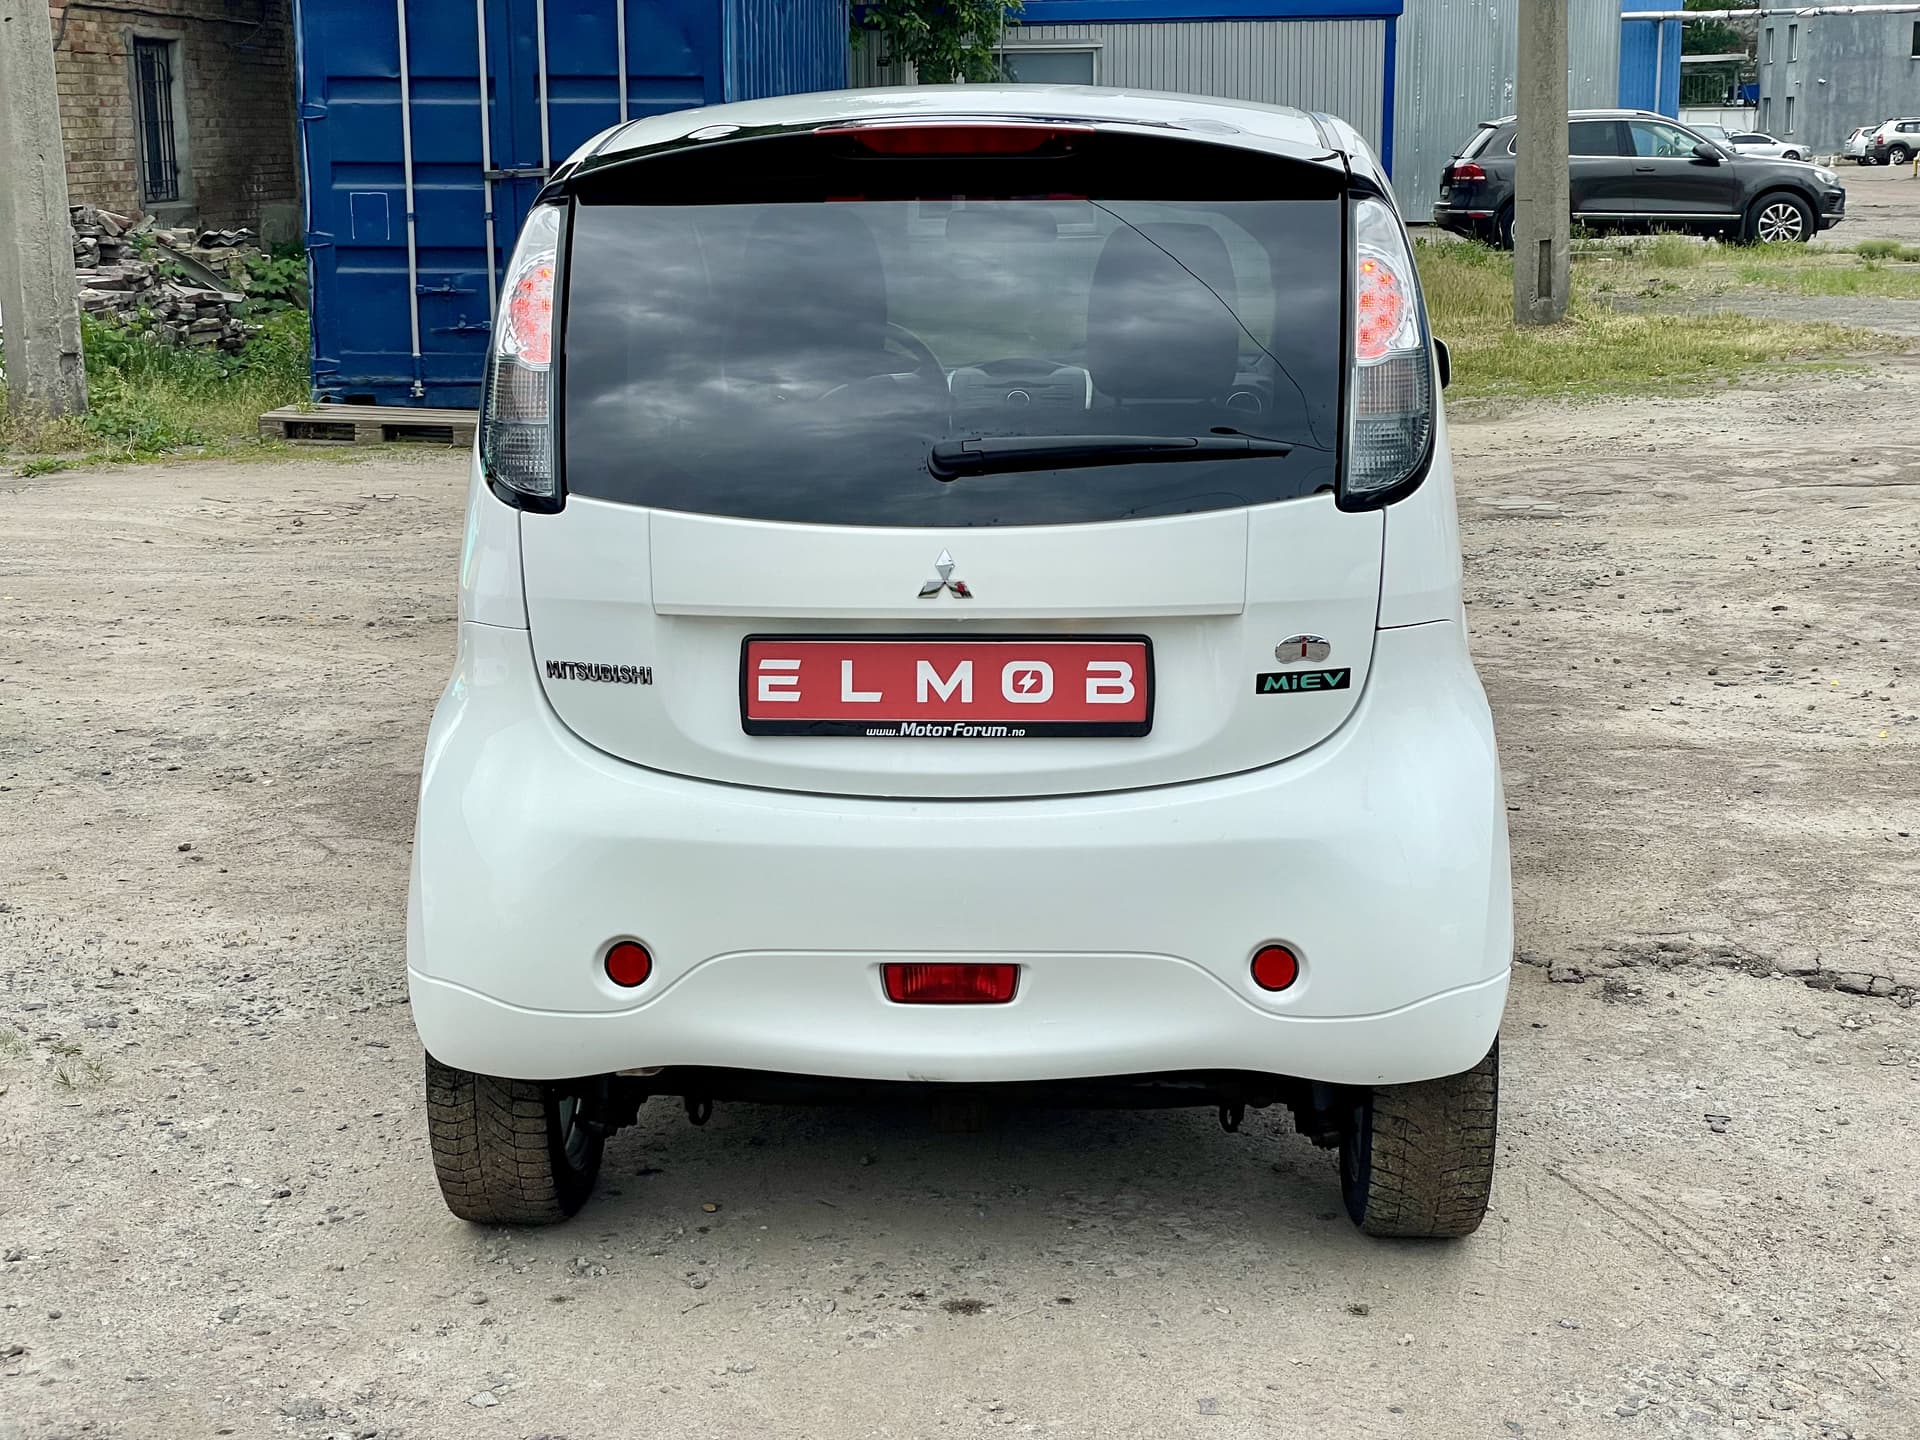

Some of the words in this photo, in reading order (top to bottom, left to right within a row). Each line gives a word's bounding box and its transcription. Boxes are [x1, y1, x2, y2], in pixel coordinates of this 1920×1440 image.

[545, 660, 653, 685] MITSUBISHI
[758, 659, 1136, 704] ELMOB
[1263, 671, 1345, 691] MiEV
[866, 722, 1026, 737] www.MotorForum.no
